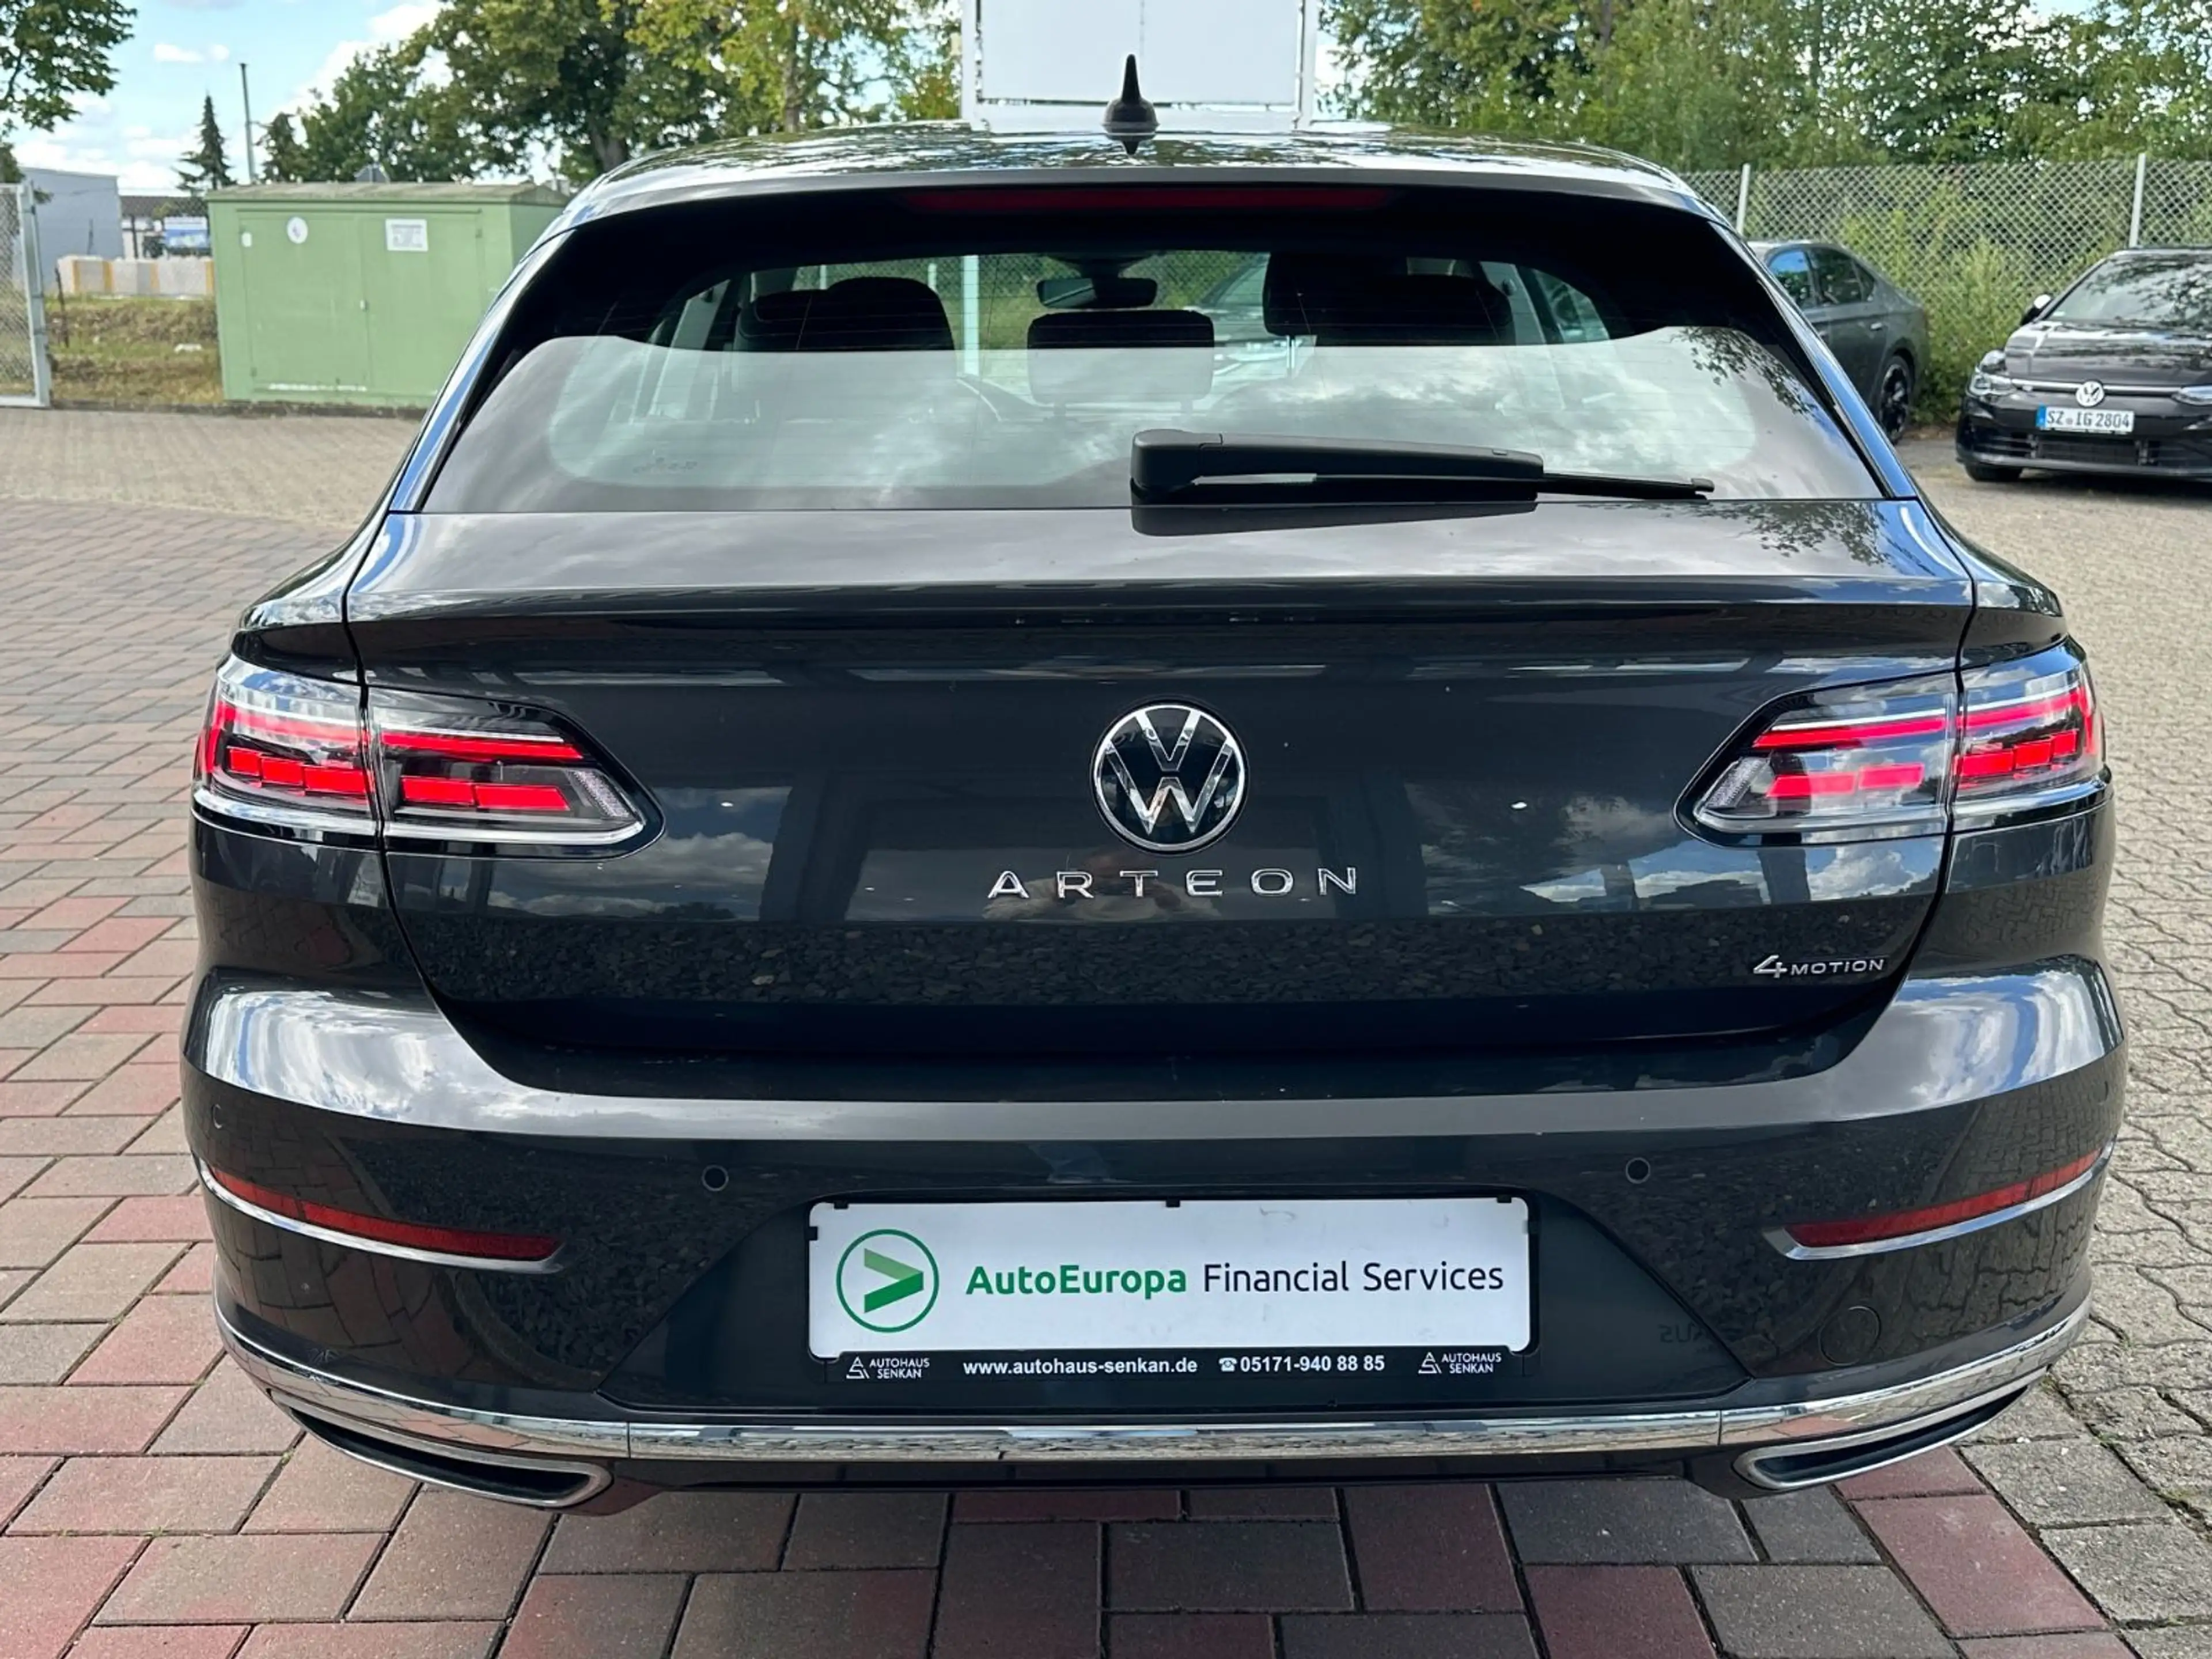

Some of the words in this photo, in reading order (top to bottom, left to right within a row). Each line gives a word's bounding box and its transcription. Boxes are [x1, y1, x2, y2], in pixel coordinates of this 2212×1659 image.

[2095, 412, 2130, 428] 2804
[987, 868, 1357, 899] ARTEON
[1753, 955, 1884, 978] 4MOTION
[965, 1264, 1187, 1298] AutoEuropa
[1205, 1261, 1349, 1292] Financial
[1363, 1261, 1503, 1291] Services
[869, 1358, 930, 1368] AUTOHAUS
[963, 1357, 1198, 1374] www.autohaus-senkan.de
[1240, 1355, 1331, 1372] 05171-940
[1337, 1355, 1358, 1371] 88
[1363, 1355, 1385, 1371] 85
[1441, 1352, 1502, 1363] AUTOHAUS
[877, 1368, 922, 1379] SENKAN
[1449, 1363, 1494, 1374] SENKAN
